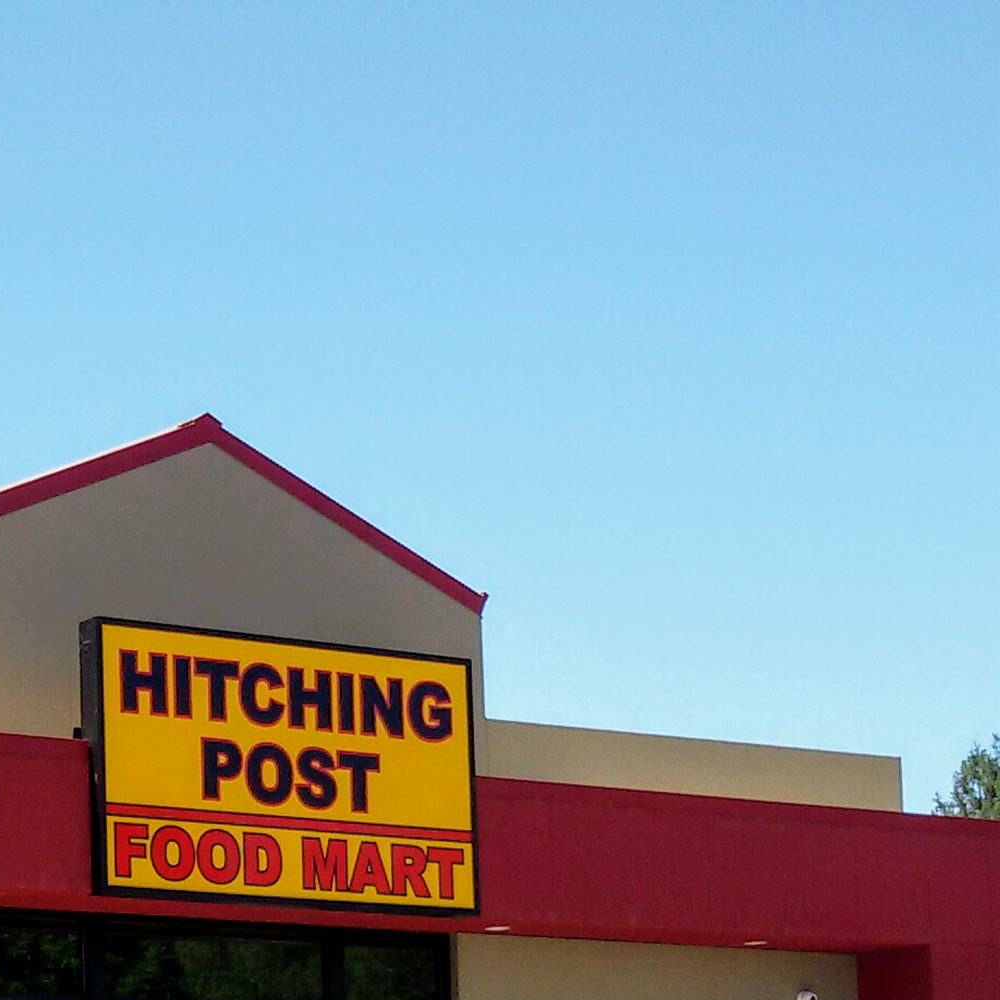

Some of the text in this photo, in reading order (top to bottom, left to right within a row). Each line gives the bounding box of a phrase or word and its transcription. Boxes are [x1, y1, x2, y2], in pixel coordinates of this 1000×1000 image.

[118, 649, 452, 743] HITCHING
[201, 737, 381, 814] POST
[114, 821, 465, 900] FOOD MART
